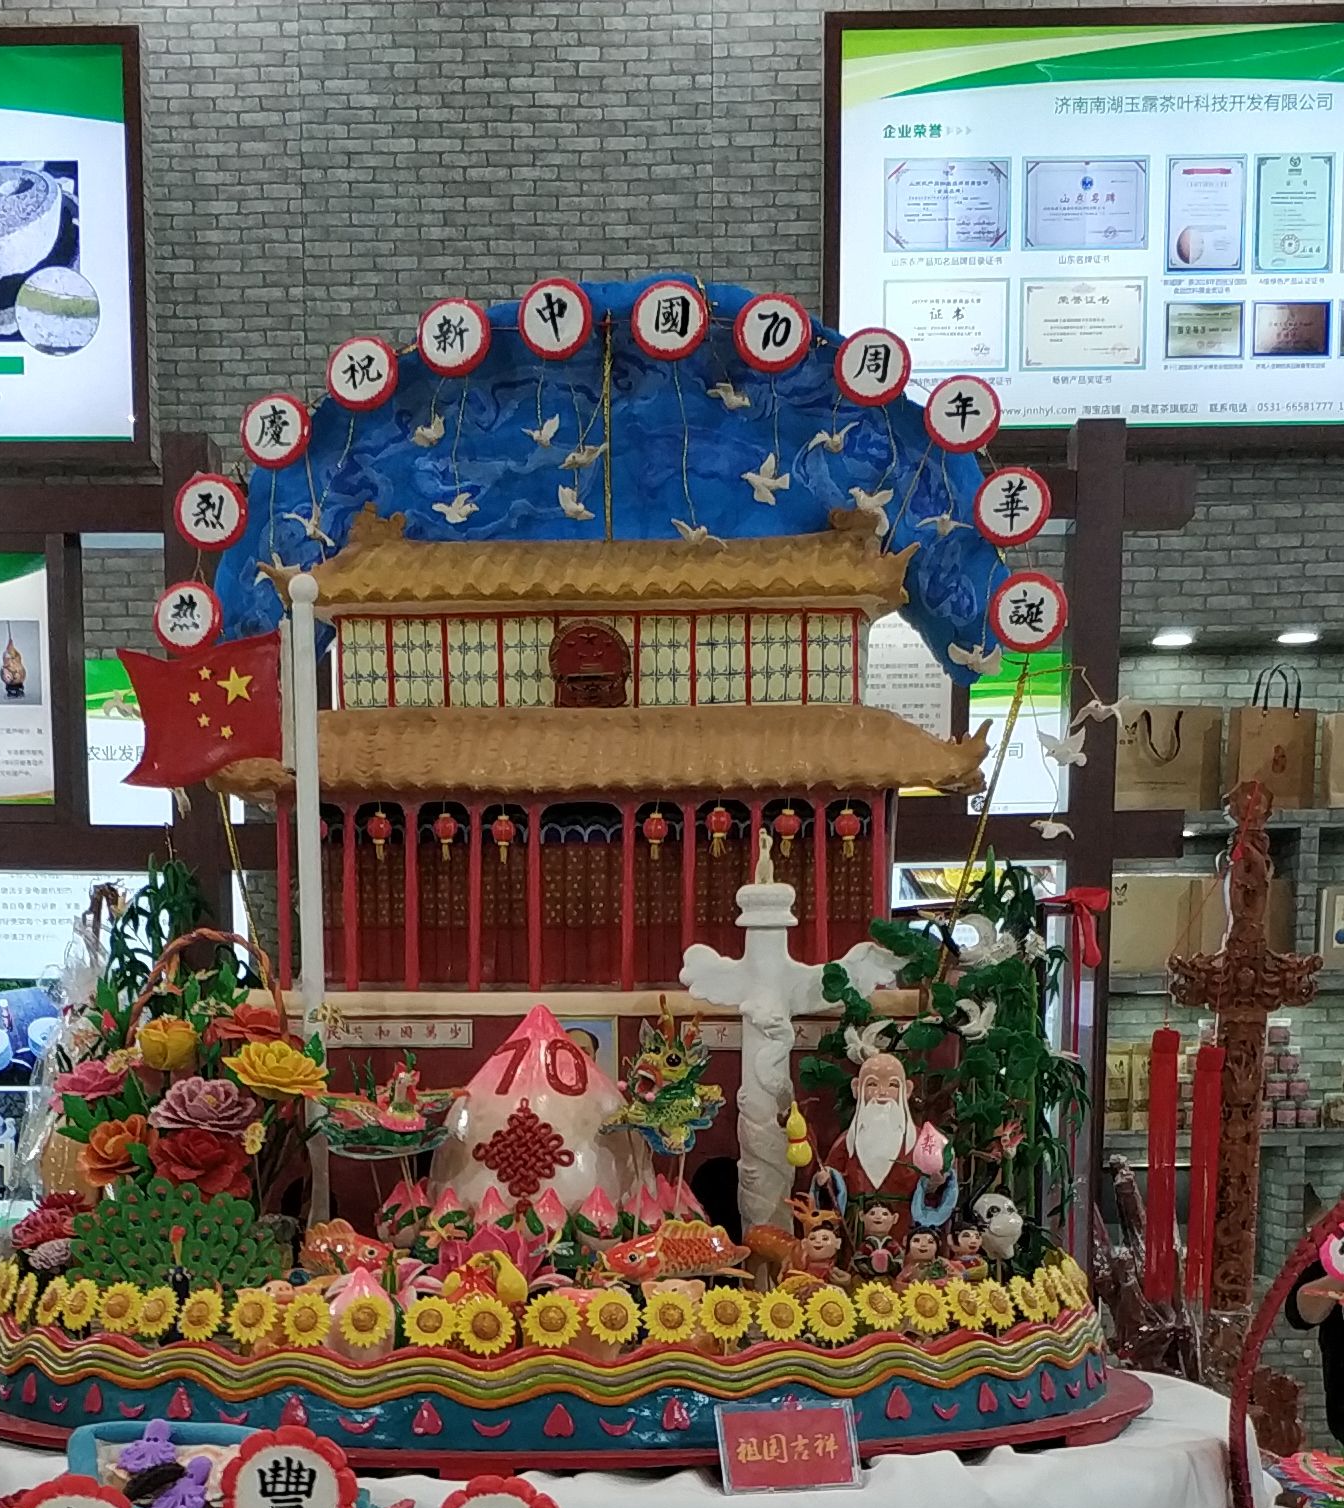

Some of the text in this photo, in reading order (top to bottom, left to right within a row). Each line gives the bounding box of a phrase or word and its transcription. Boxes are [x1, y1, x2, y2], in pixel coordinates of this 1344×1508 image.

[1054, 94, 1333, 115] 济南南湖玉露茶叶科技开发有限公司
[882, 123, 943, 140] 企业荣誉
[494, 1037, 589, 1096] 70
[736, 1433, 839, 1464] 祖国吉祥
